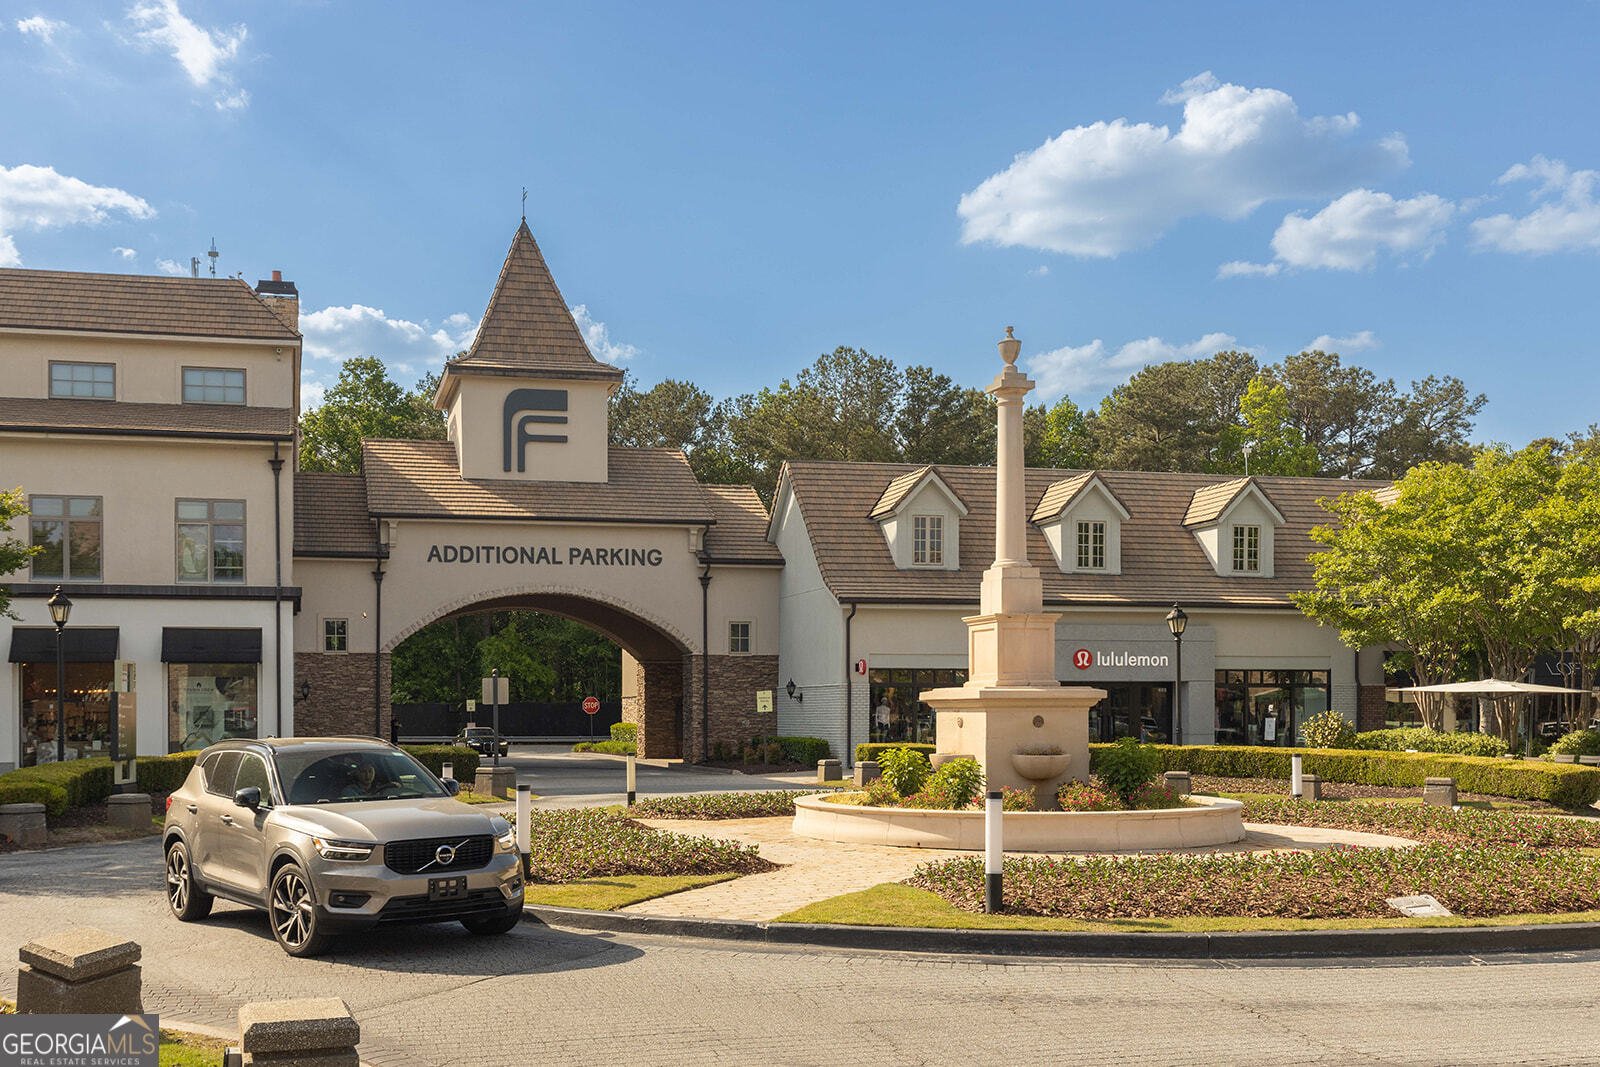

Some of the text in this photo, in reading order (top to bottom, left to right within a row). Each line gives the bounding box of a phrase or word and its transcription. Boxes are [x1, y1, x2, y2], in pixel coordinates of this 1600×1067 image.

[427, 544, 663, 567] ADDITIONAL PARKING
[1097, 651, 1169, 666] lululemon
[584, 701, 598, 710] STOP
